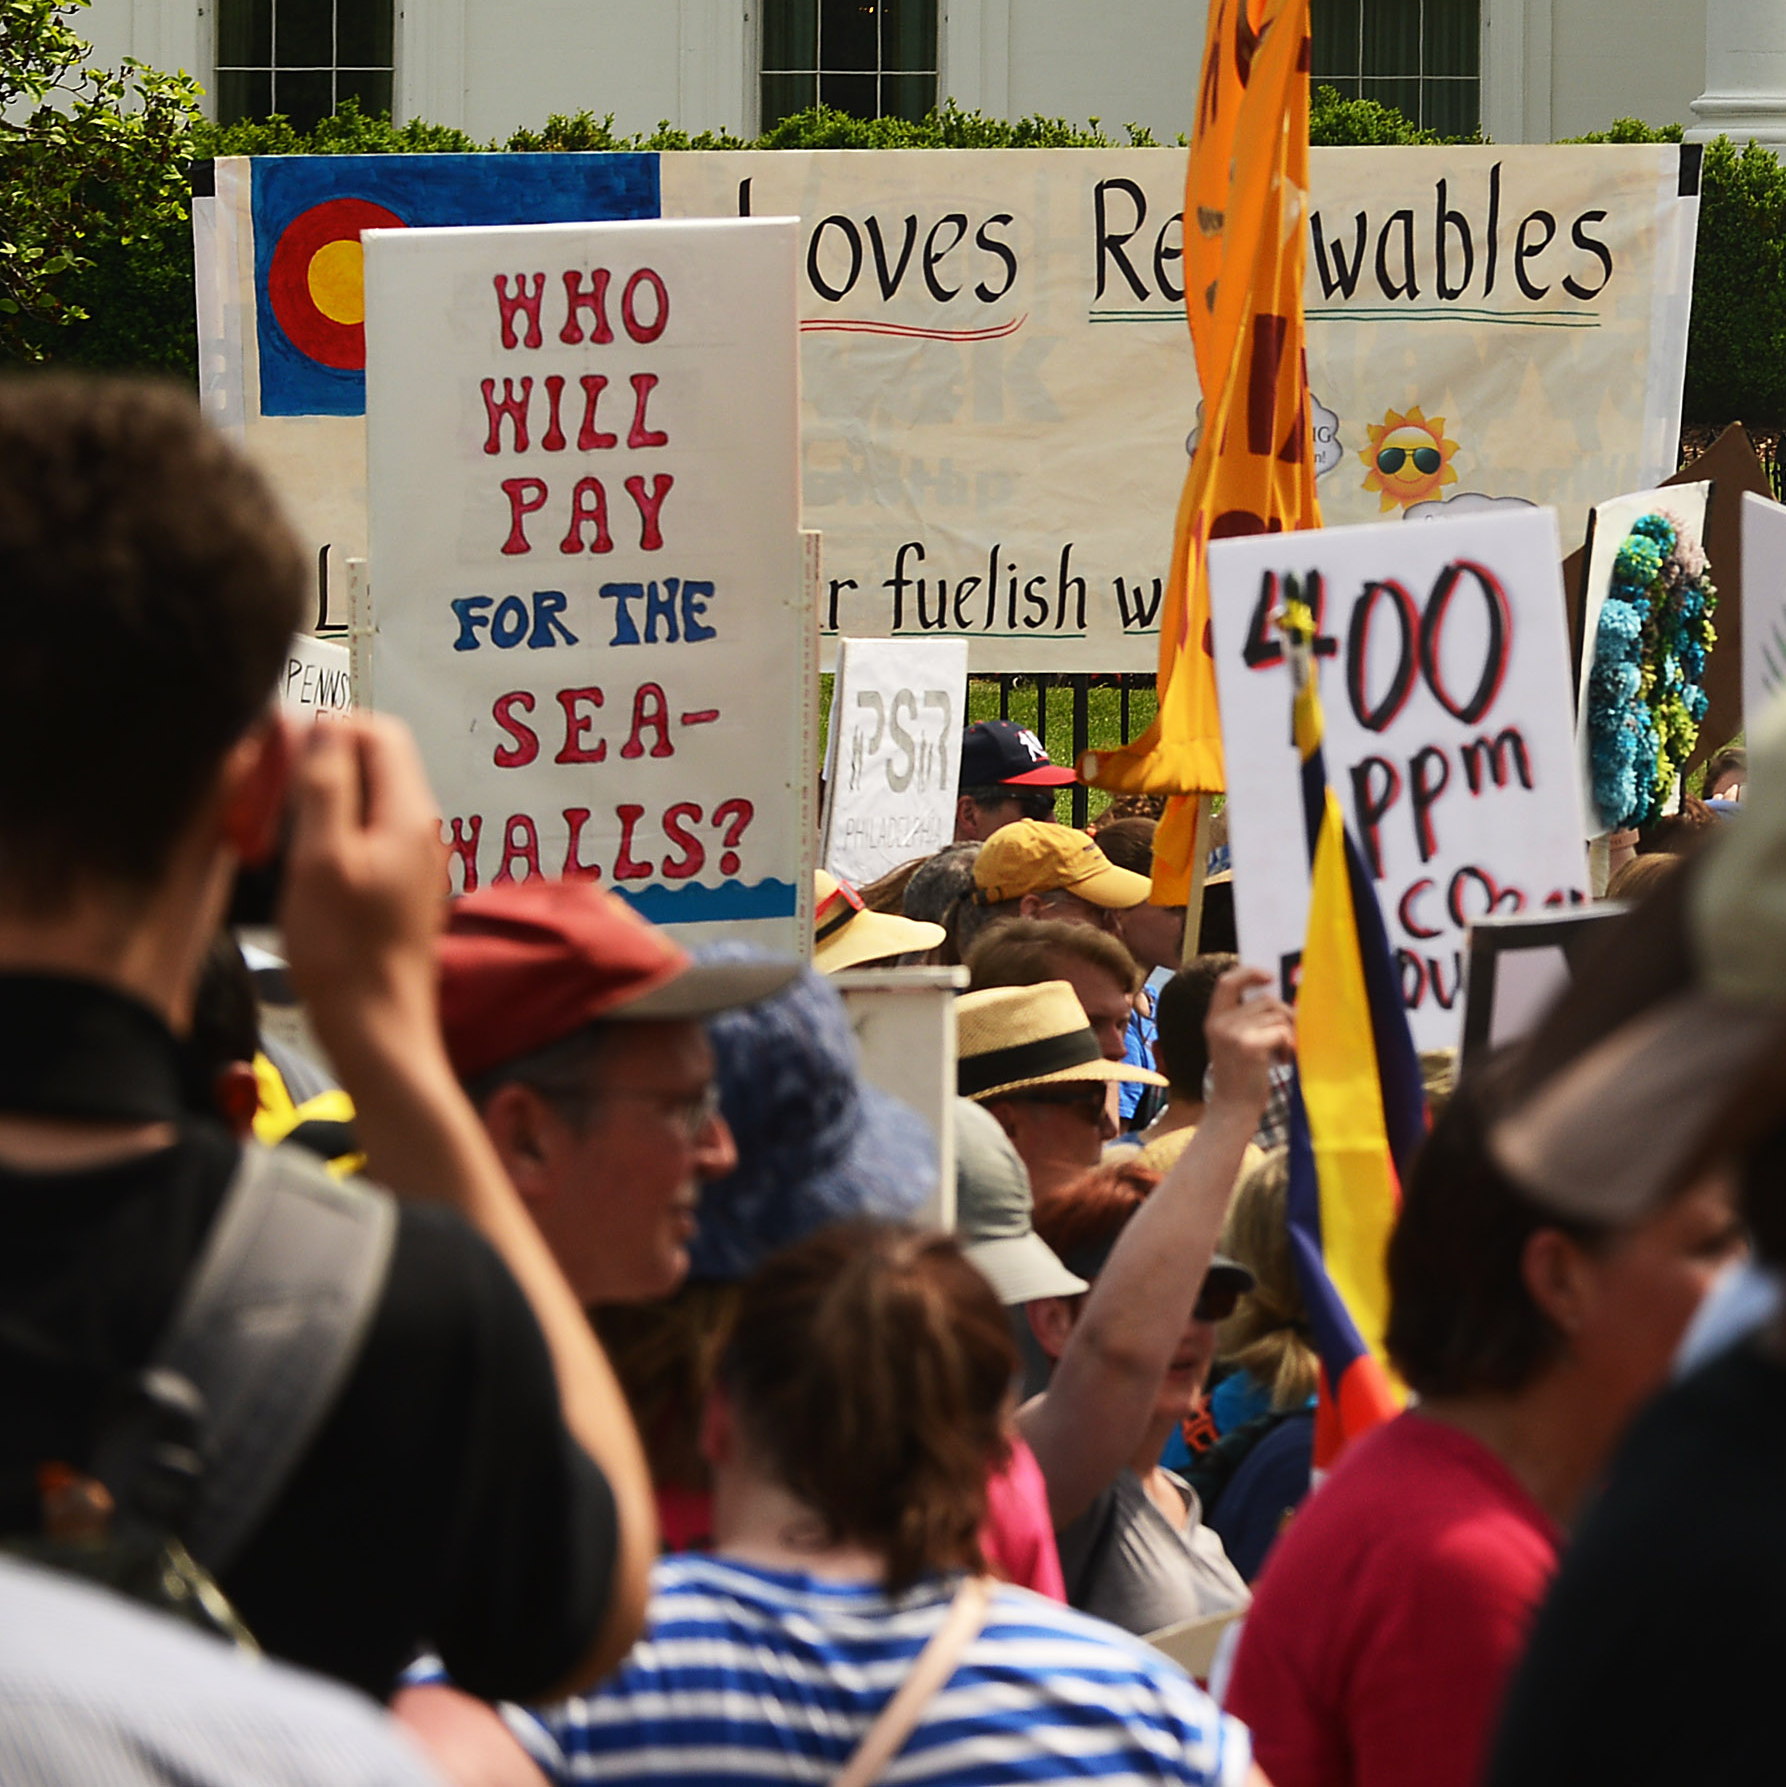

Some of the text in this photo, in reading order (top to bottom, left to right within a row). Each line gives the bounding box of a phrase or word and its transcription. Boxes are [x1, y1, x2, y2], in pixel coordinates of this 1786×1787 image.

[493, 267, 670, 349] WHO
[480, 373, 671, 455] WILL
[500, 474, 675, 556] PAY
[452, 577, 717, 651] FOR THE
[882, 540, 1087, 632] fuelish
[1242, 558, 1512, 732] 400
[491, 682, 721, 768] SEA-
[1351, 726, 1534, 882] ppm
